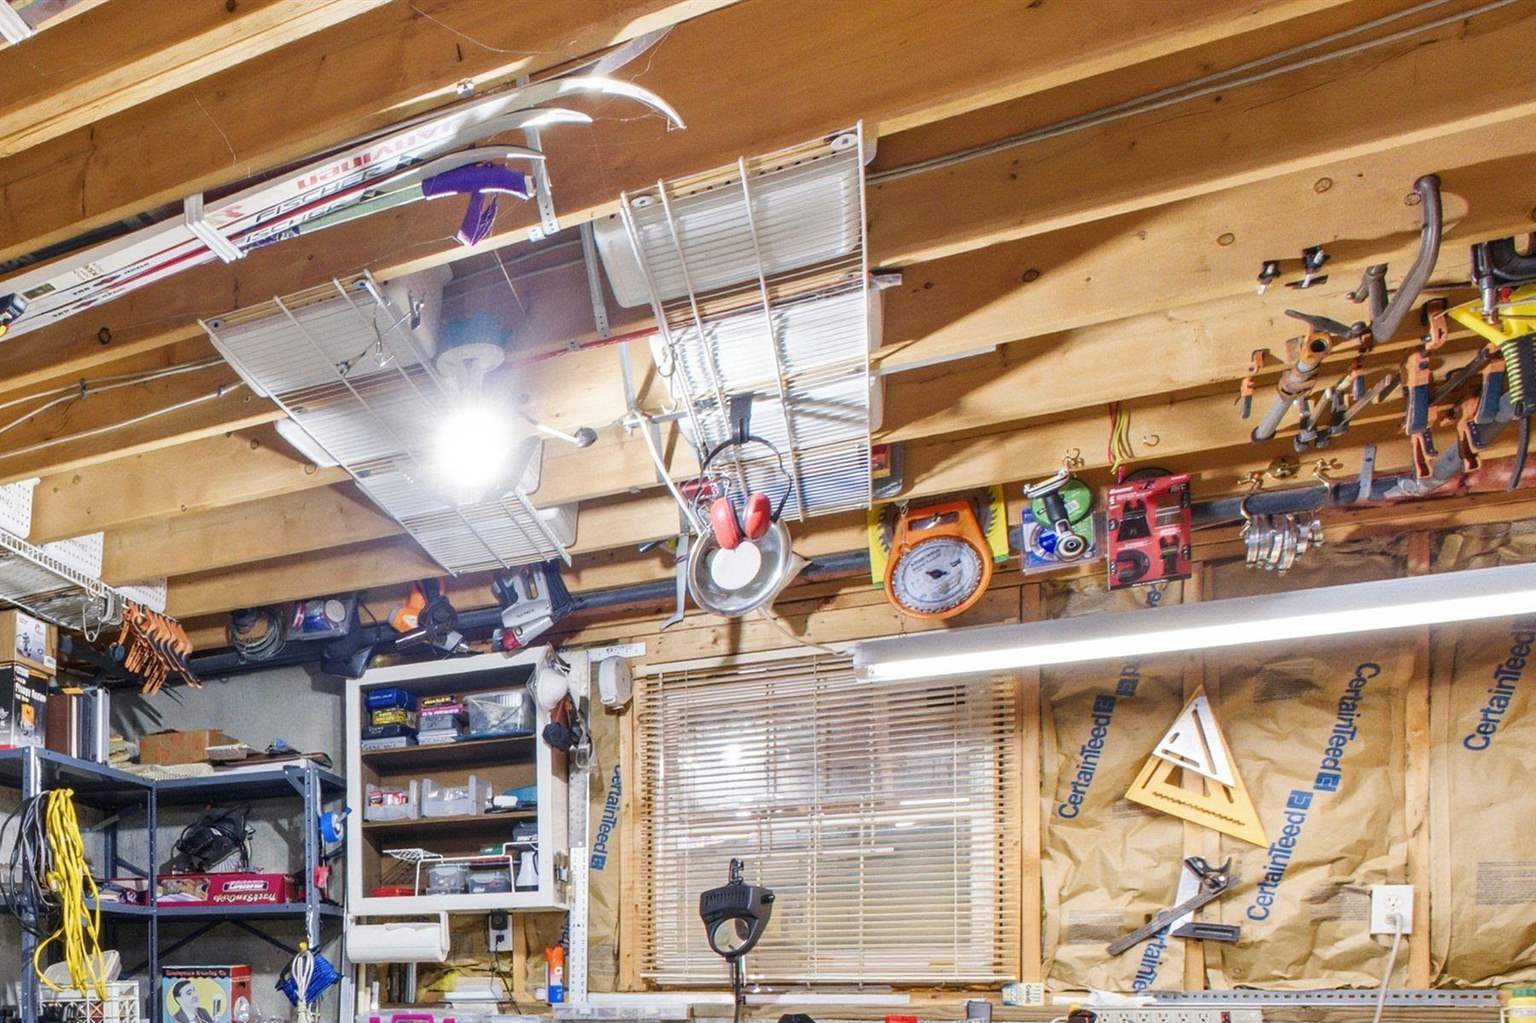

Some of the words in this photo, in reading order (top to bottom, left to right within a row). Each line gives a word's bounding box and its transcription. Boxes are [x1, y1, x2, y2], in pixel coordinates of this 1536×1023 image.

[1057, 712, 1113, 819] CertainTeed
[1320, 662, 1381, 772] CertainTeed
[1247, 810, 1306, 922] CertainTeed
